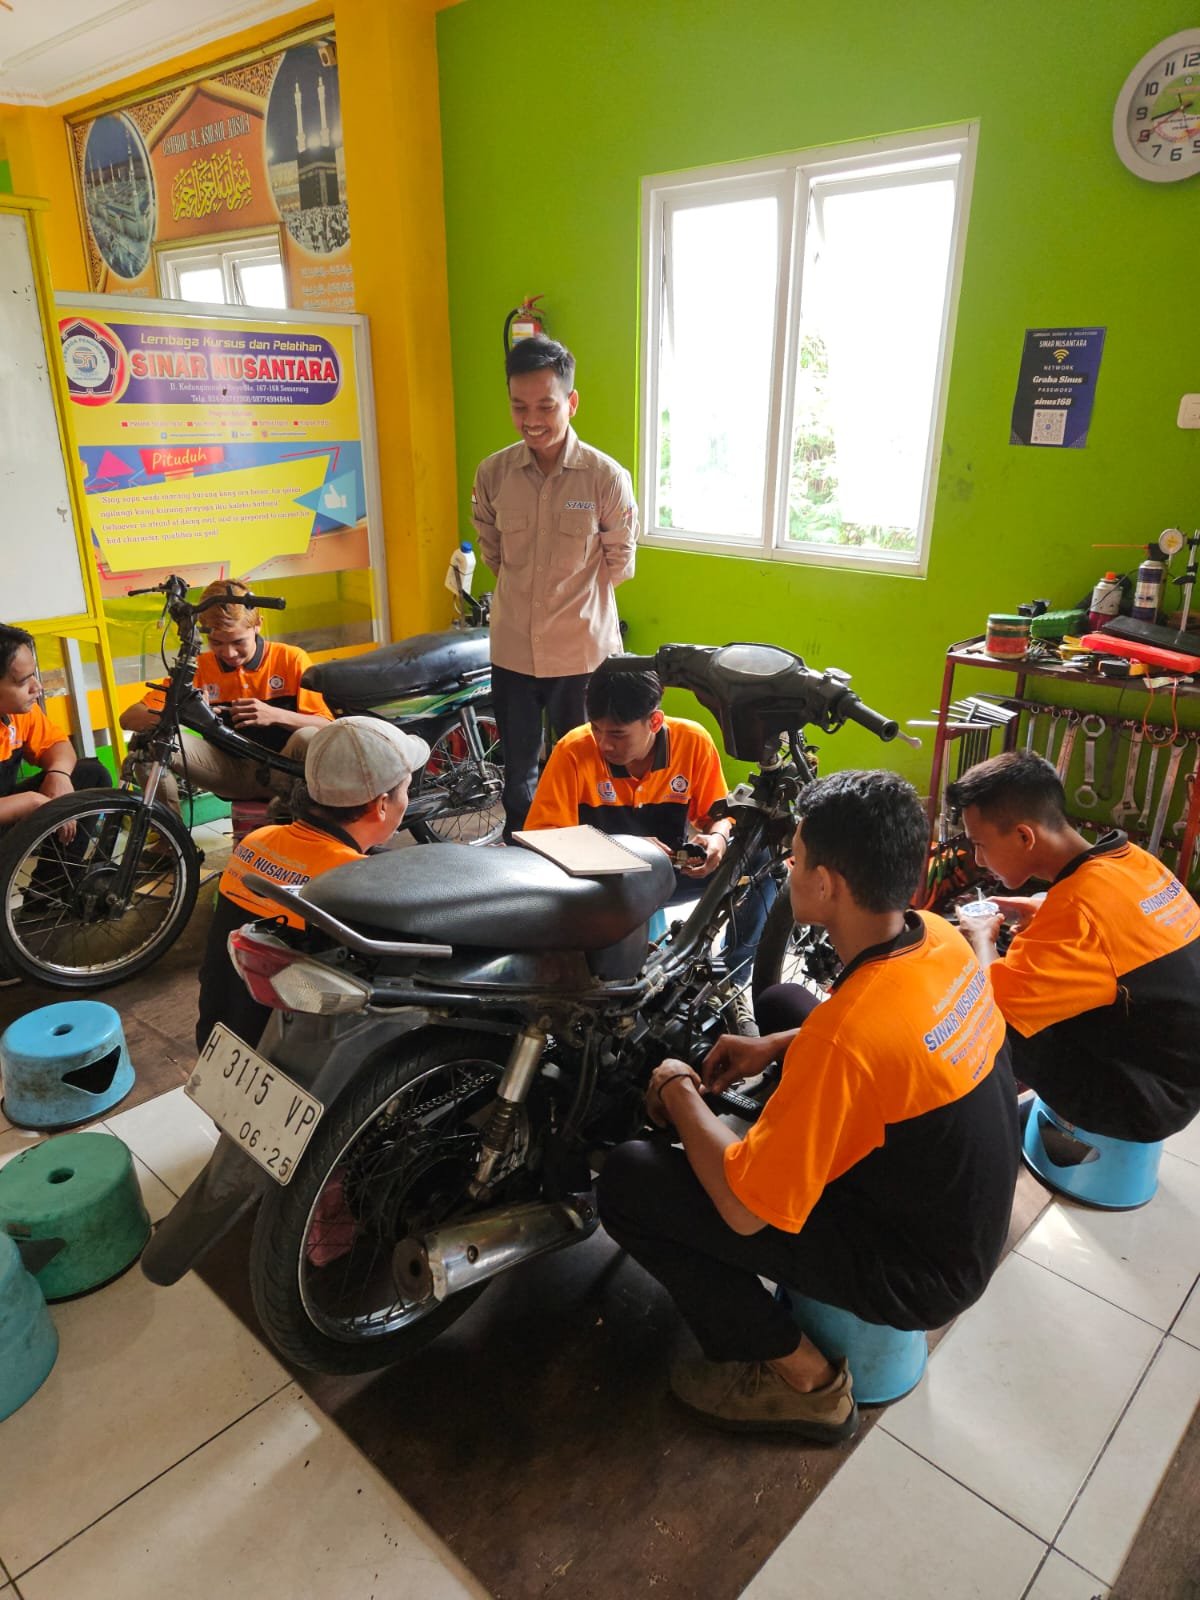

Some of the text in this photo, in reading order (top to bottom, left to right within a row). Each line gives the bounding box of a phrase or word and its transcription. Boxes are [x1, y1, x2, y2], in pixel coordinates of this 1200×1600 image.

[1164, 62, 1176, 76] 11
[1145, 81, 1159, 96] 10
[1136, 106, 1148, 120] 9
[1138, 129, 1150, 142] 8
[1151, 144, 1162, 158] 7
[1170, 148, 1182, 162] 6
[141, 333, 322, 352] Lembaga Kursus dan Pelatihan
[131, 351, 337, 382] SINAR NUSANTARA
[152, 447, 208, 470] Pituduh
[254, 856, 311, 886] NUSANTAR
[924, 1011, 960, 1052] SINAR
[202, 1031, 316, 1136] H 3115 VP
